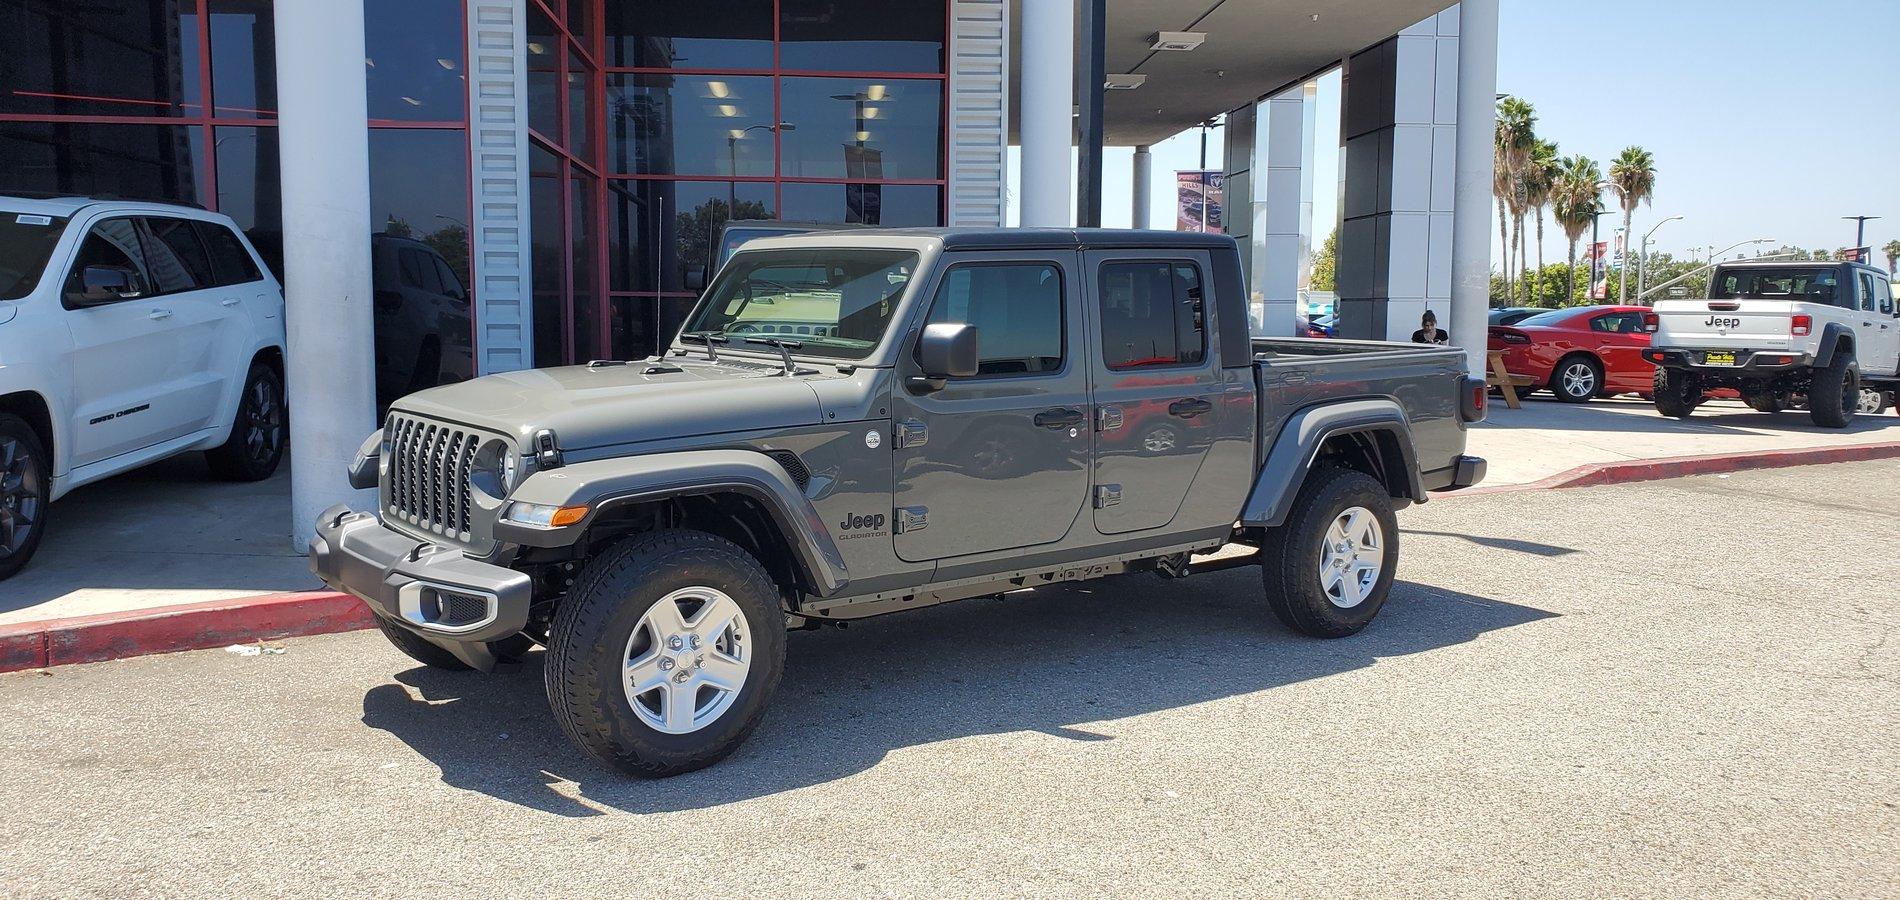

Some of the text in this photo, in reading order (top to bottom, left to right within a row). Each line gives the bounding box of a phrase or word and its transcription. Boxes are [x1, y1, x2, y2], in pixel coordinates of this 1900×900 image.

[1704, 315, 1741, 329] Jeep
[89, 413, 115, 425] GRAND
[840, 512, 885, 531] Jeep
[838, 531, 888, 541] GLADIATOR
